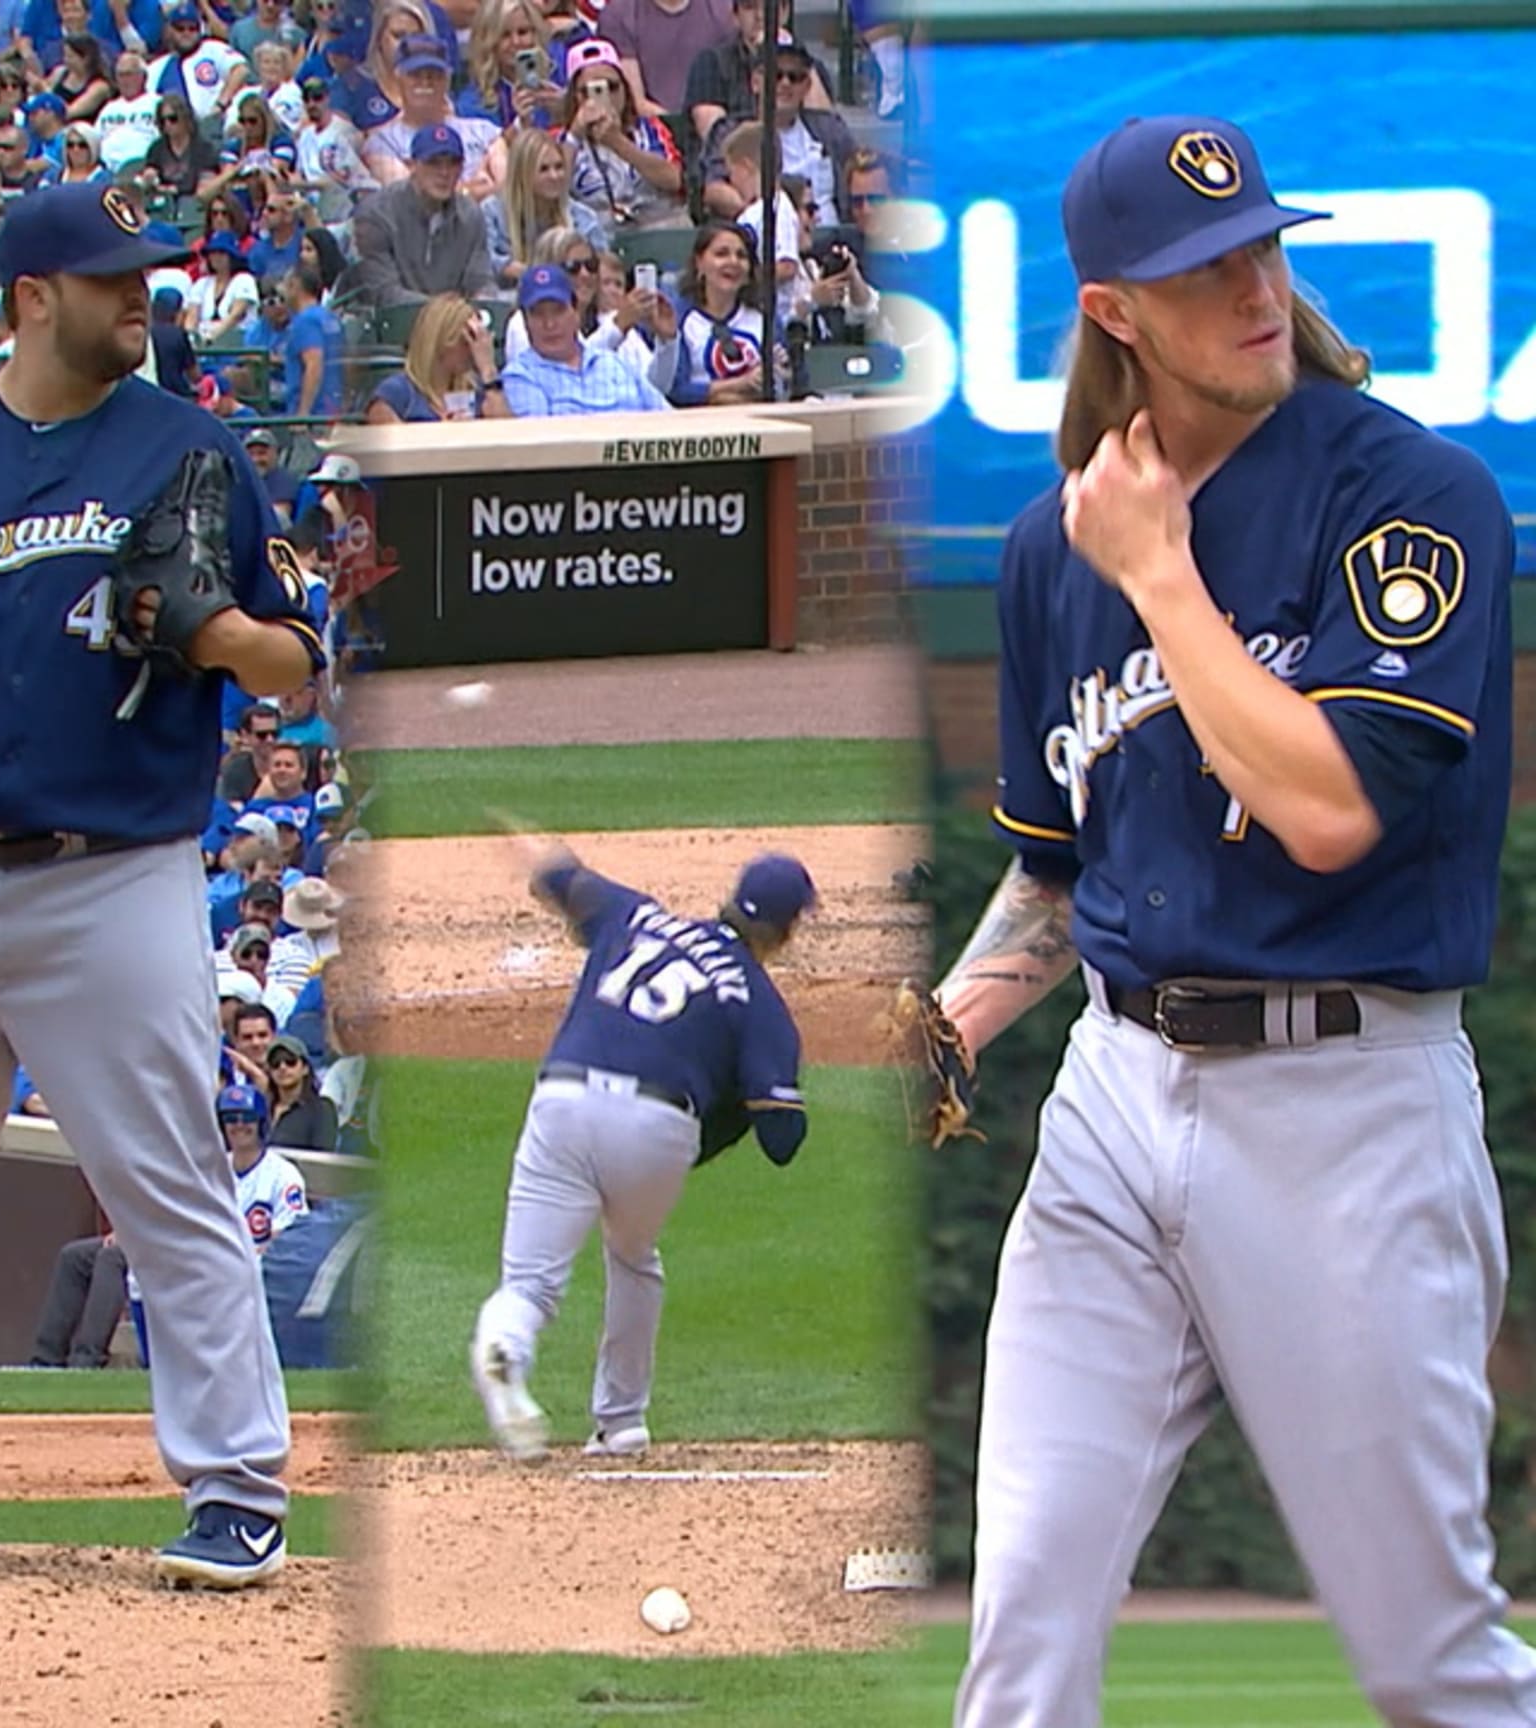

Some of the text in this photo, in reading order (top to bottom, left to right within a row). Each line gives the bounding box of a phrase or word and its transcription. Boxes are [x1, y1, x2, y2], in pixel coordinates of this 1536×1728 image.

[602, 433, 762, 463] #EVERYBODYIN
[471, 485, 746, 538] Now brewing
[471, 547, 674, 593] low rates.
[596, 934, 710, 1024] 15
